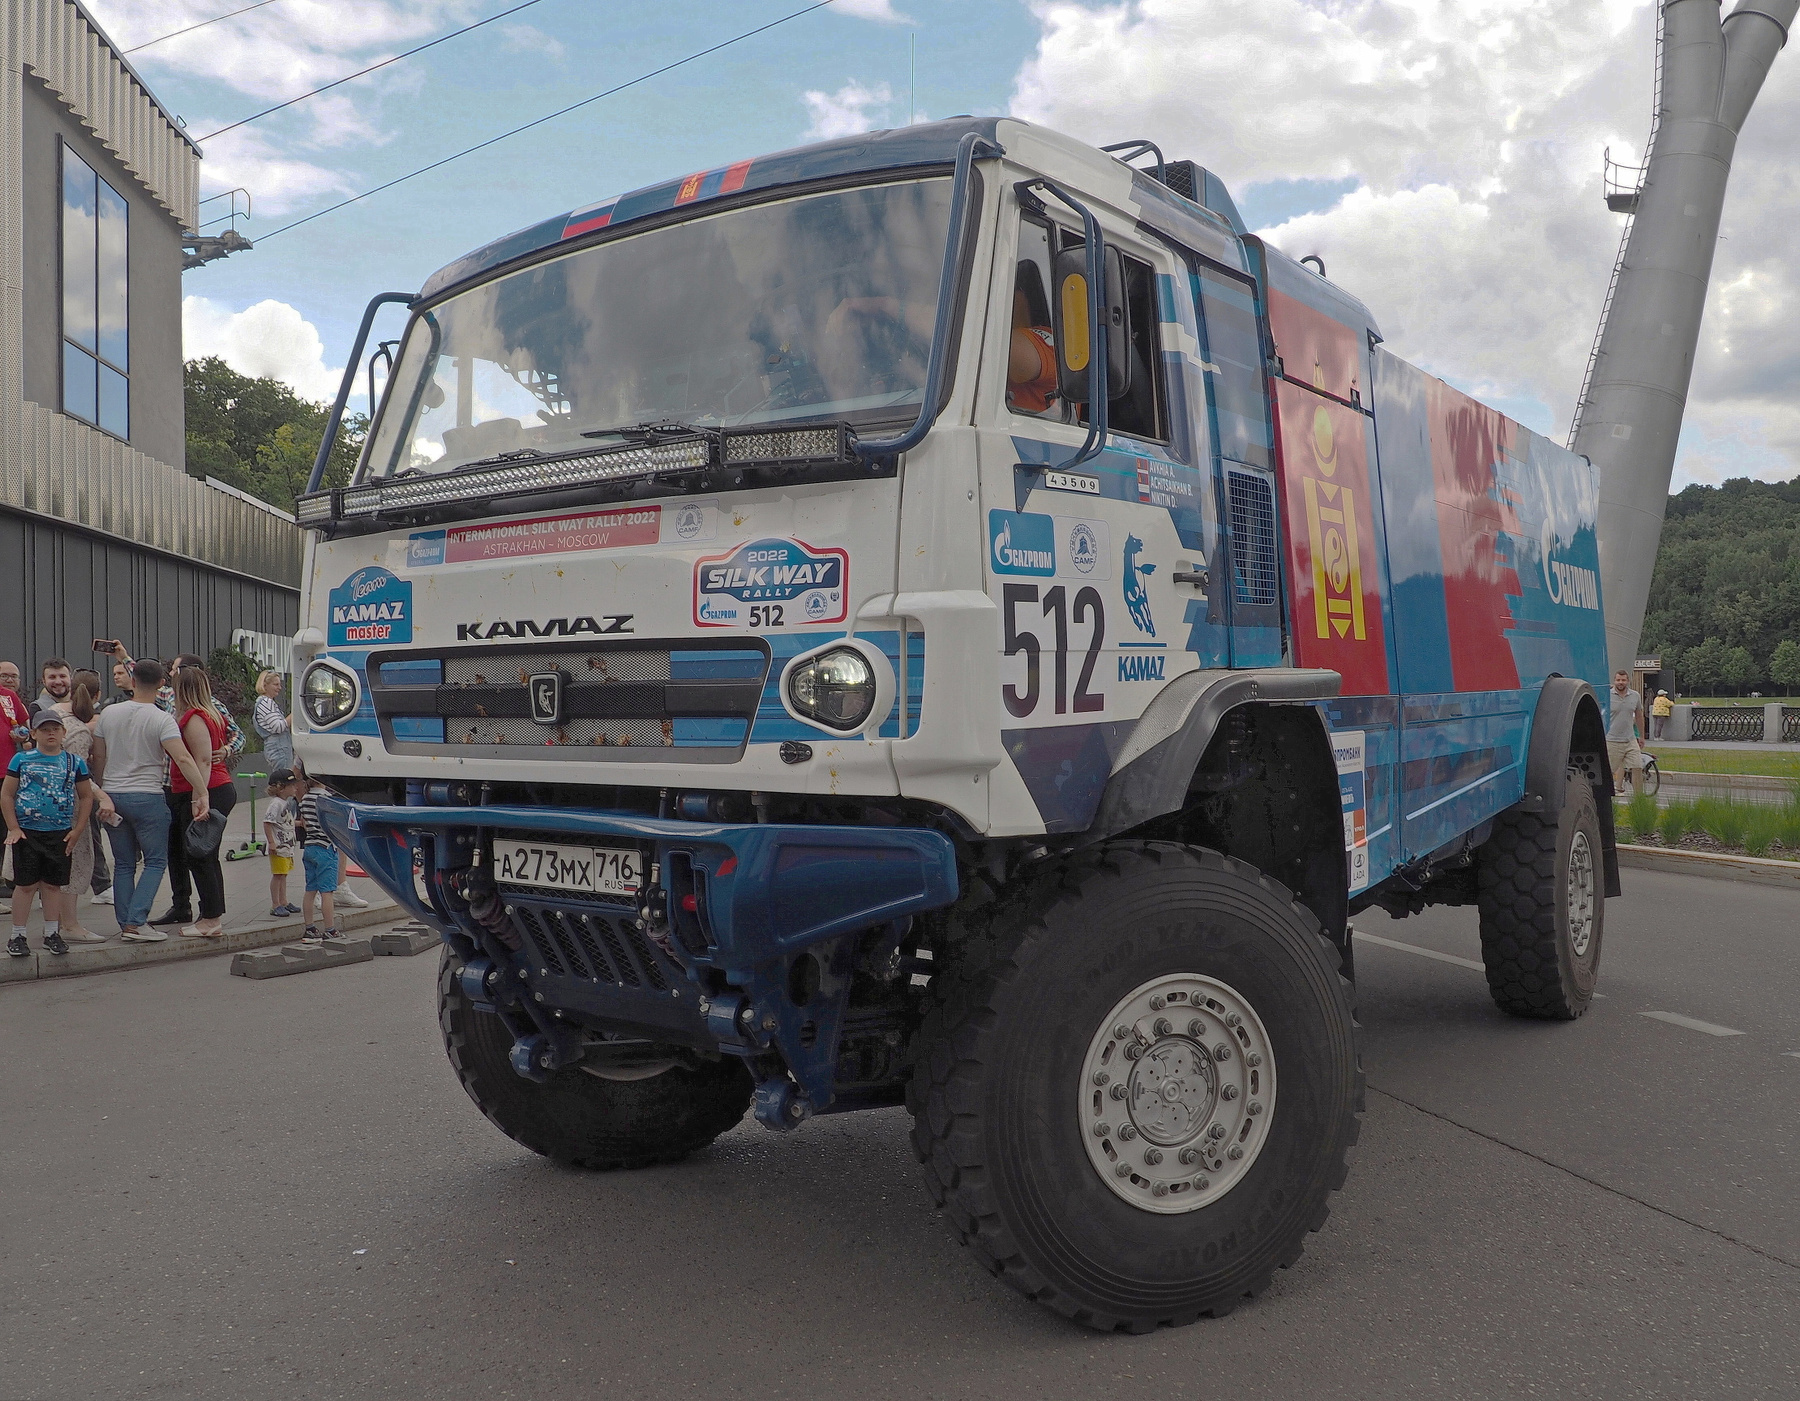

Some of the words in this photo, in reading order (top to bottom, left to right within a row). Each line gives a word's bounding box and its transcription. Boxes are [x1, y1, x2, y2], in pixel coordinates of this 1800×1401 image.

[1050, 475, 1096, 491] 43509
[1151, 491, 1171, 508] NIKITIN
[450, 524, 530, 544] INTERNATIONAL
[531, 521, 556, 536] SILK
[558, 518, 586, 534] WAY
[586, 513, 625, 530] RALLY
[626, 511, 656, 526] 2022
[483, 540, 546, 556] ASTRAKHAN
[557, 533, 609, 549] MOSCOW
[747, 550, 788, 562] 2022
[1011, 549, 1053, 569] GAZPROM
[351, 572, 387, 601] Team
[706, 566, 770, 589] SILK
[773, 563, 834, 586] WAY
[1560, 562, 1599, 610] GAZPROM
[742, 588, 793, 598] RALLY
[333, 602, 404, 624] KAMAZ
[710, 609, 737, 619] GAZPROM
[749, 605, 785, 627] 512
[347, 623, 391, 640] master
[457, 614, 635, 641] KAMAZ
[1002, 583, 1105, 718] 512
[1118, 656, 1166, 682] KAMAZ
[595, 852, 634, 880] 716
[1353, 870, 1365, 881] LADA
[605, 880, 624, 890] RUS
